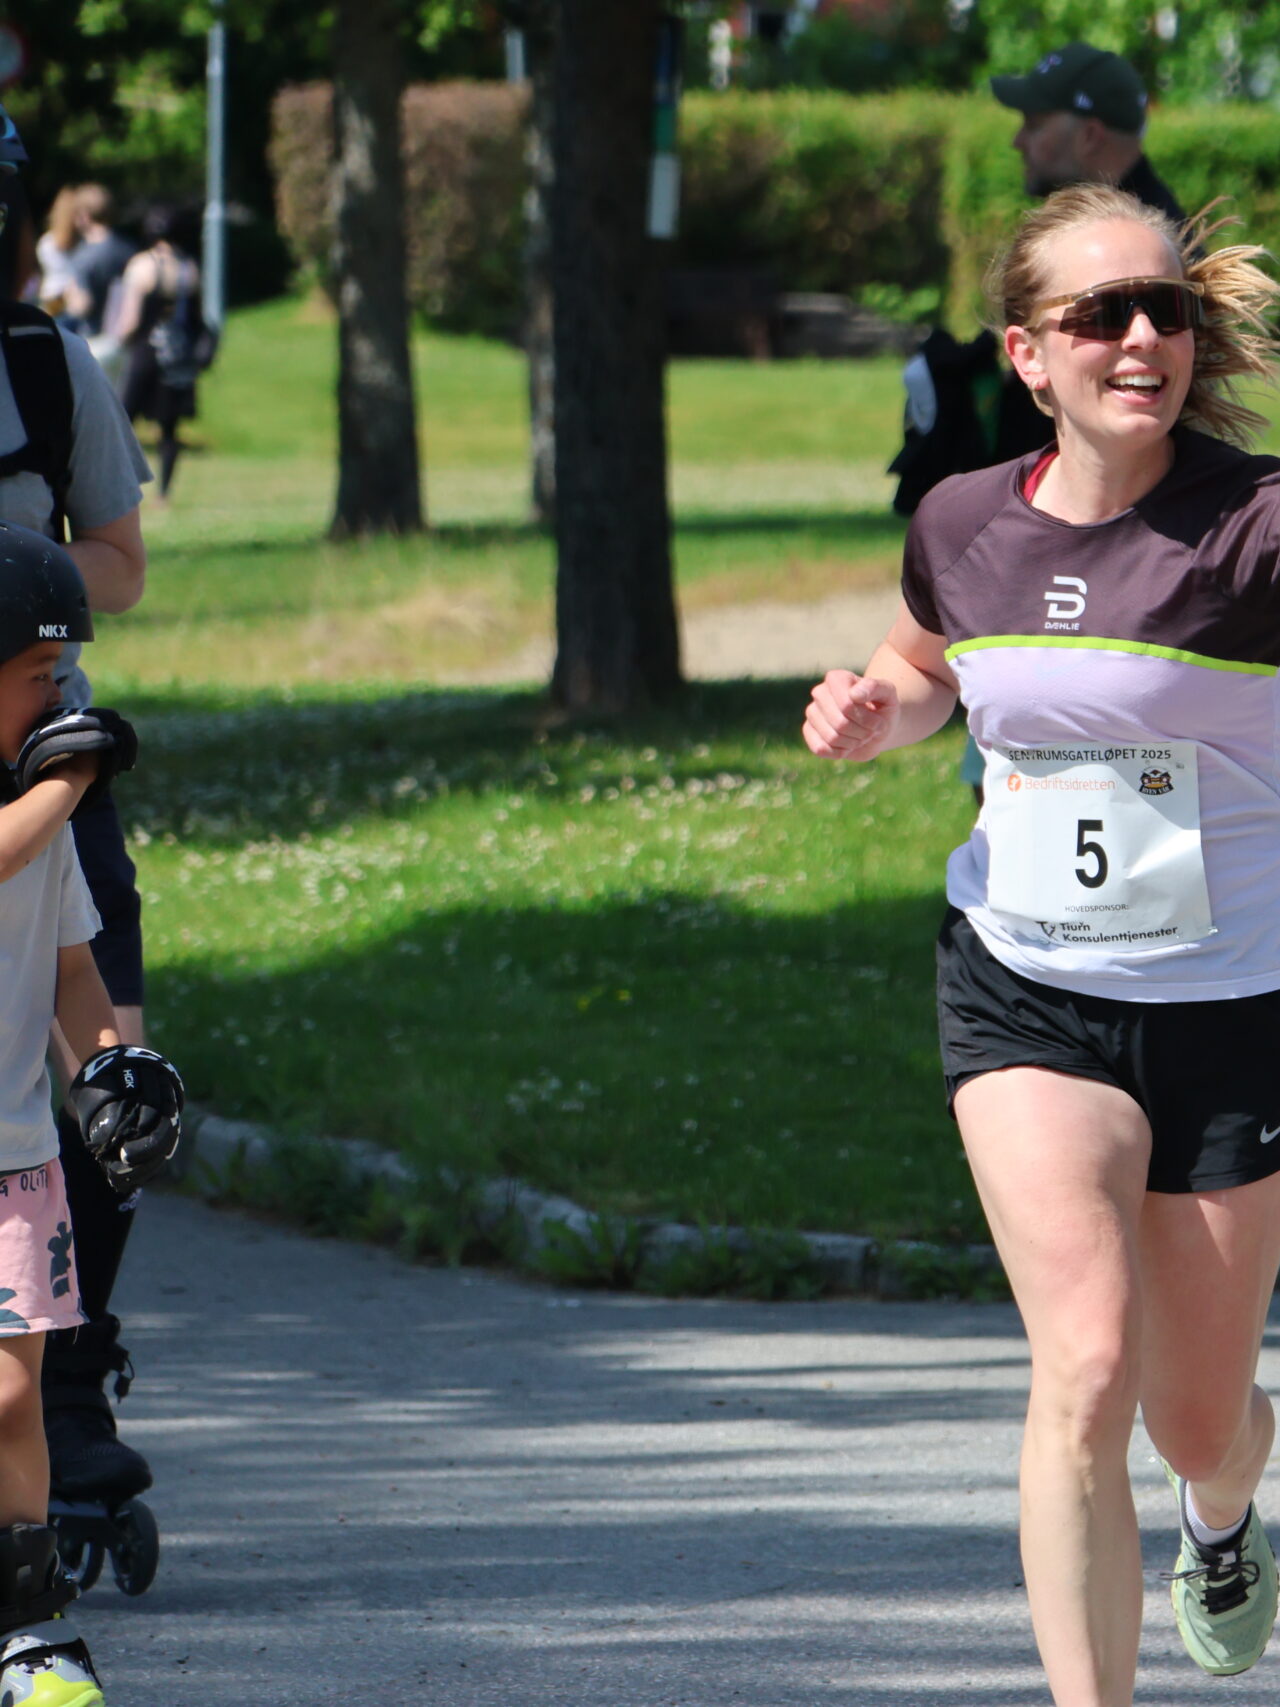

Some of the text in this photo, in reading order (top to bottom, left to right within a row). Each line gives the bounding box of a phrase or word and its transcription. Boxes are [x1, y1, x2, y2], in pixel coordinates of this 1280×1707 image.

[38, 624, 68, 638] NKX
[1008, 748, 1172, 762] SENTRUMSGATELØPET 2025
[1024, 776, 1116, 792] Bedriftsidretten
[1075, 819, 1109, 889] 5
[1062, 926, 1179, 943] Konsulenttjenester
[123, 1068, 135, 1089] HGK
